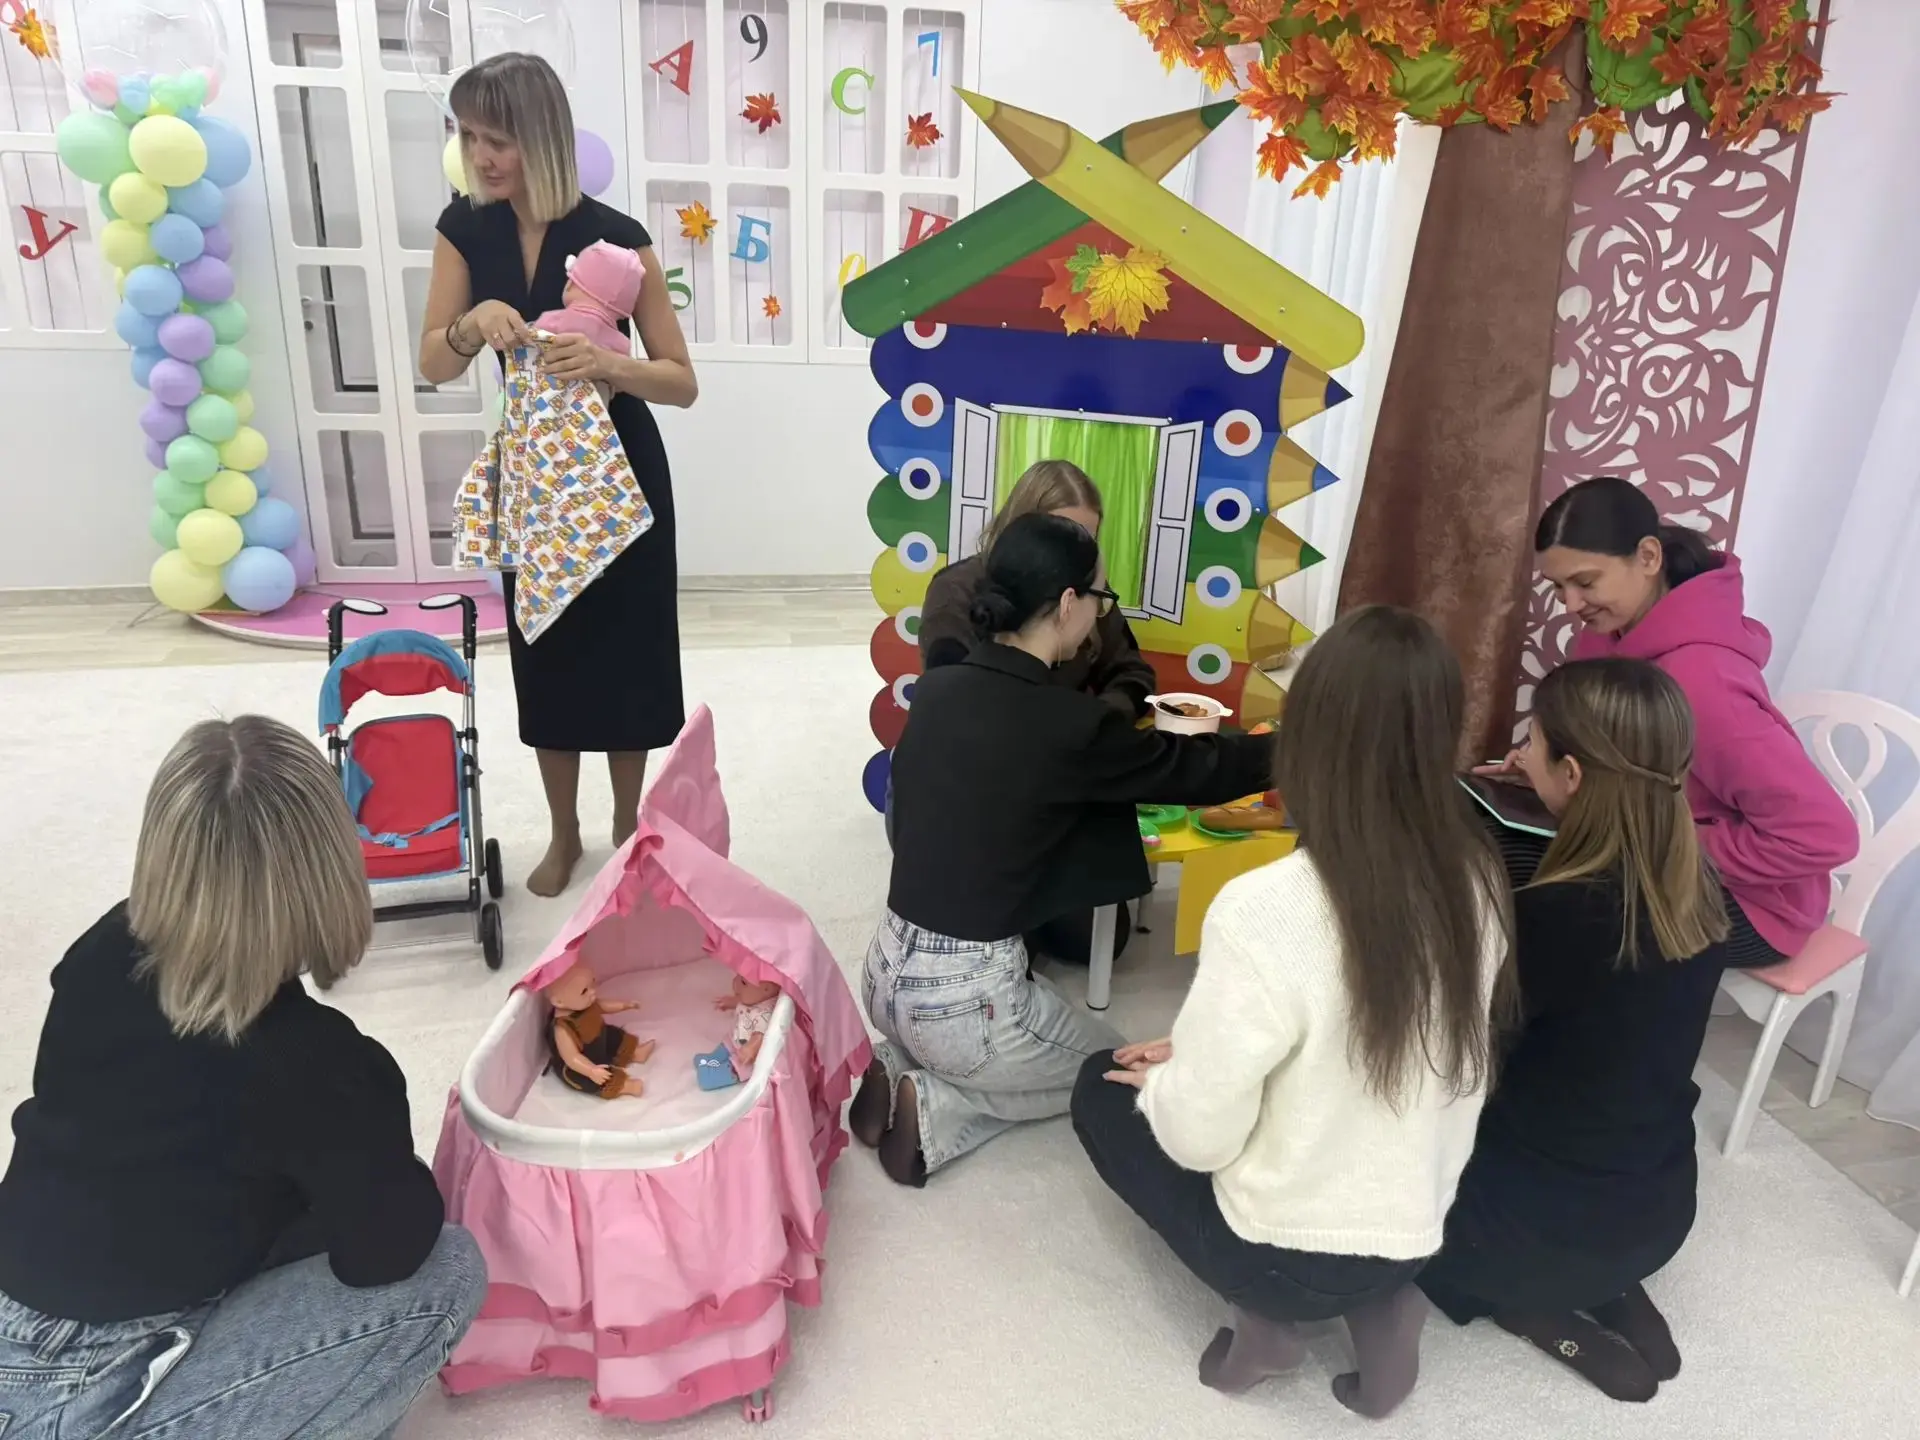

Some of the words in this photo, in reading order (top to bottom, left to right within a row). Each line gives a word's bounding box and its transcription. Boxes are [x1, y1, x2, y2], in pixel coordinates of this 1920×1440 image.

[740, 14, 769, 63] 9
[917, 31, 940, 77] 7
[648, 39, 694, 96] А
[19, 204, 78, 261] У
[730, 213, 772, 264] Б
[664, 266, 692, 311] 5
